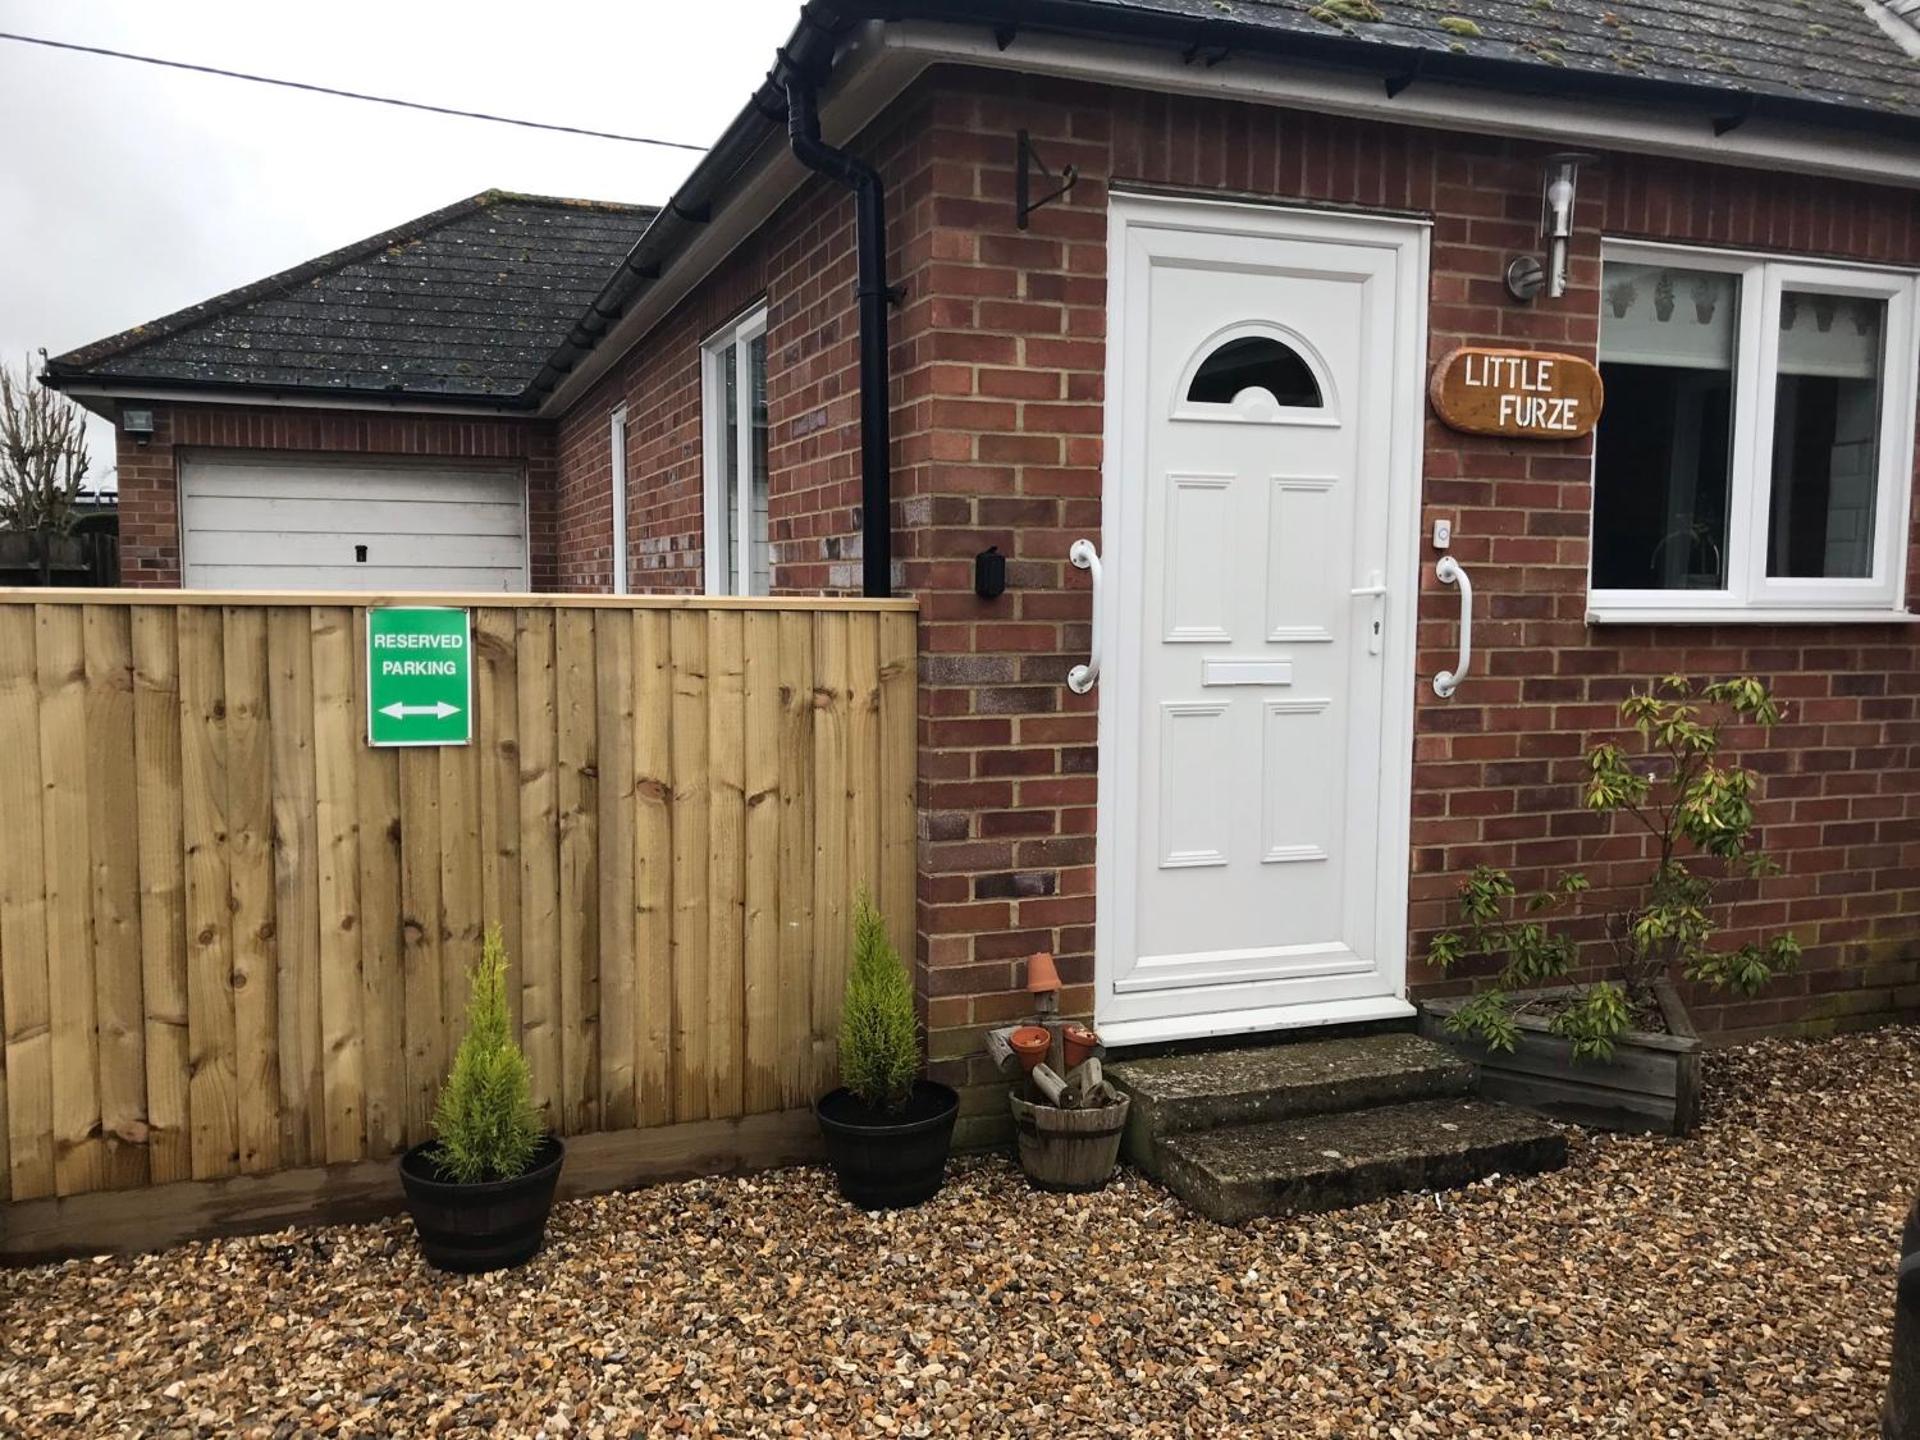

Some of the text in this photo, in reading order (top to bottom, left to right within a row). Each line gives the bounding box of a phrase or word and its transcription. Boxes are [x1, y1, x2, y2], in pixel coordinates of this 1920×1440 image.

[1465, 355, 1553, 391] LITTLE
[1499, 394, 1579, 430] FURZE
[374, 634, 463, 648] RESERVED
[382, 661, 456, 675] PARKING
